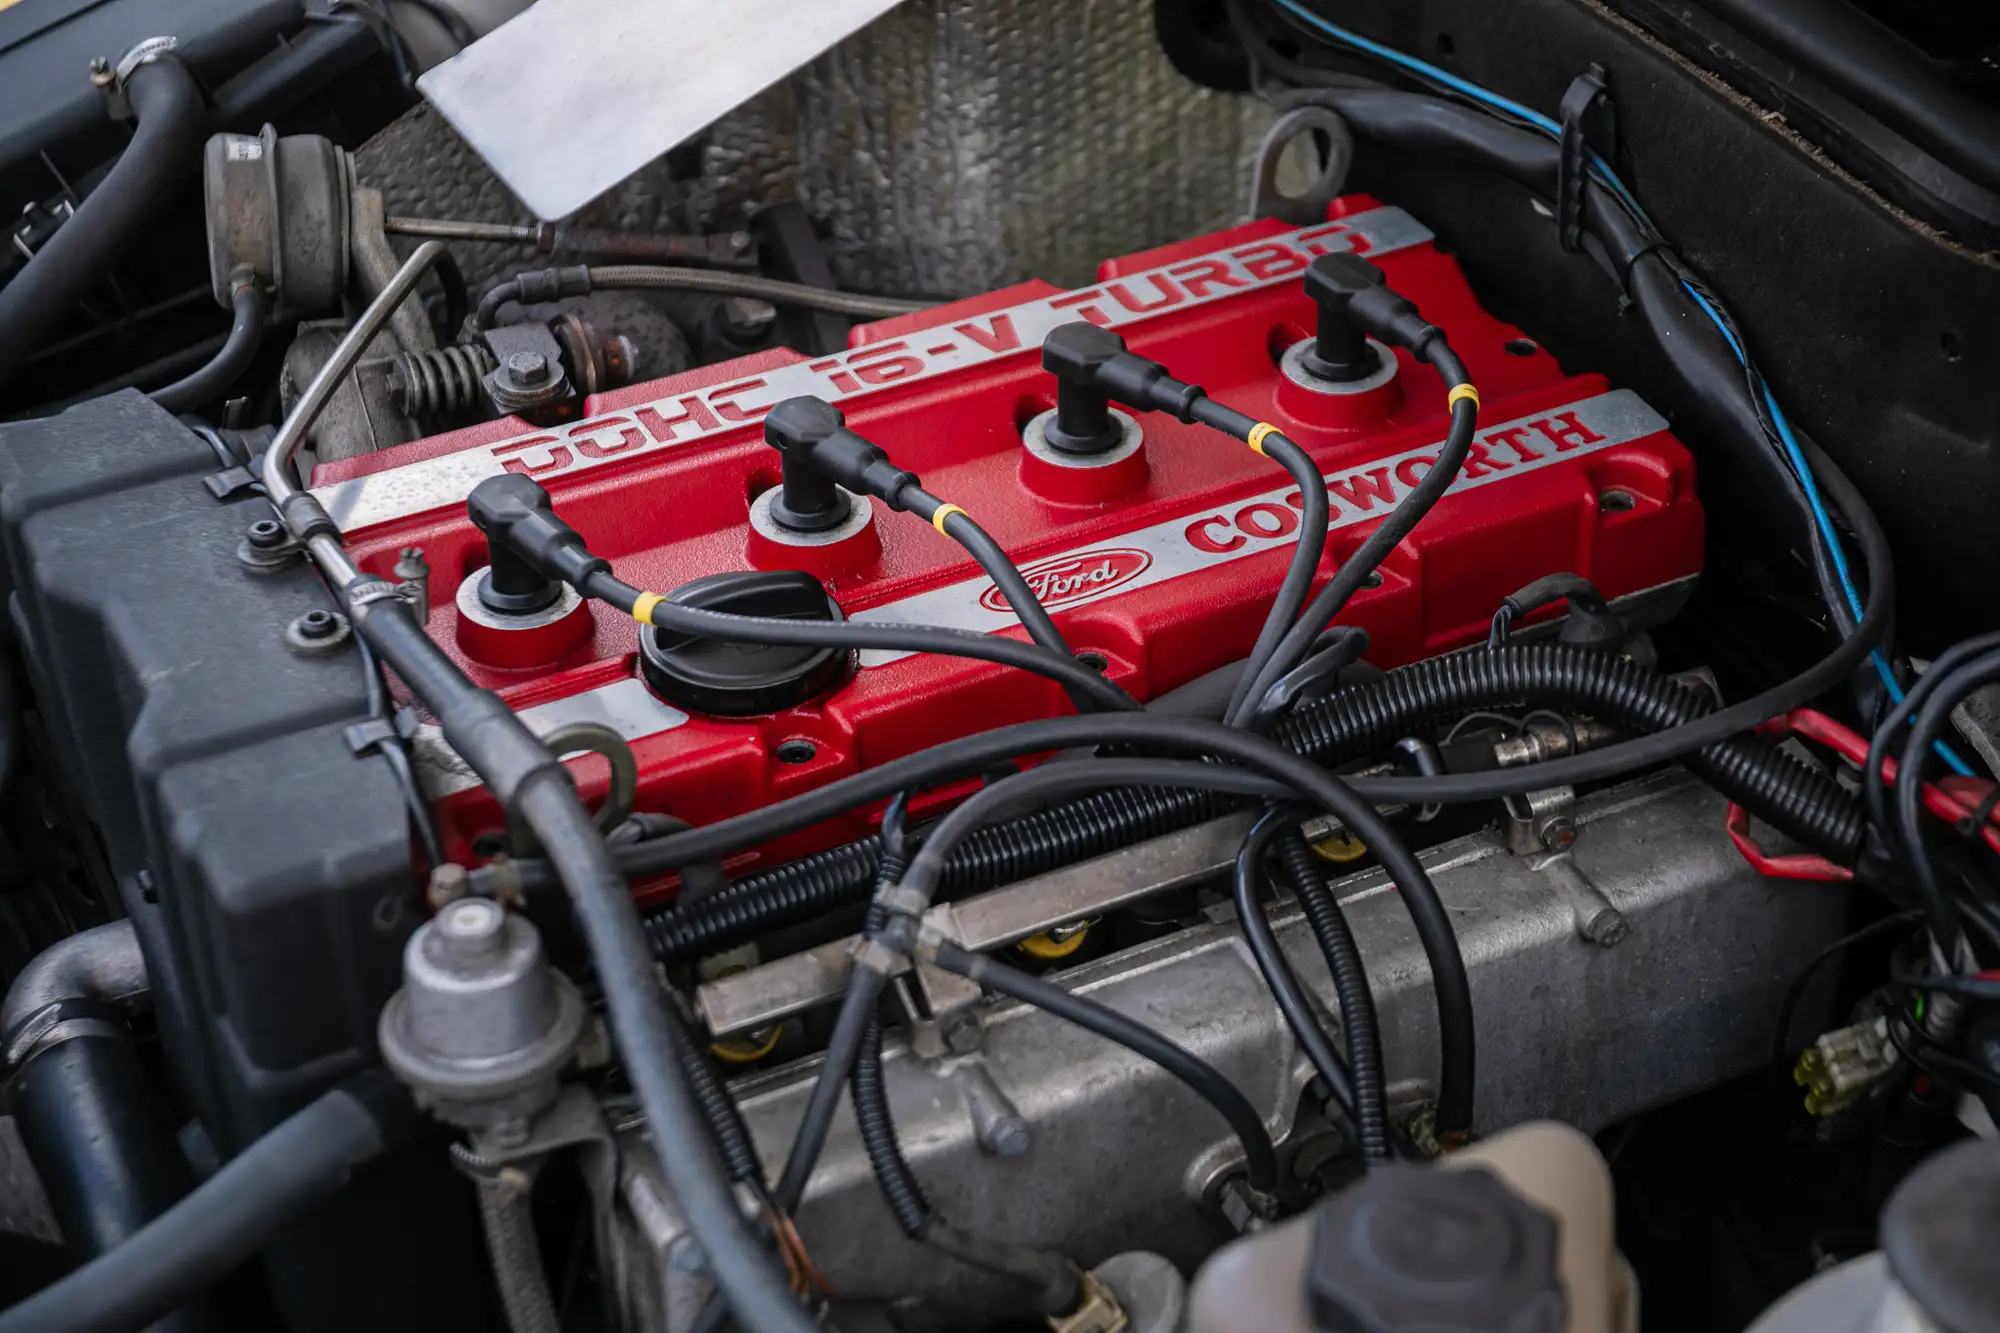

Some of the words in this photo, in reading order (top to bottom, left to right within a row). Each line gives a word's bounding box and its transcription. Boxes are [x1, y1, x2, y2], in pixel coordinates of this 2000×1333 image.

[490, 378, 775, 477] DOHC
[809, 314, 1022, 394] 16-V
[1048, 225, 1373, 327] TURBO
[1025, 559, 1118, 601] Ford
